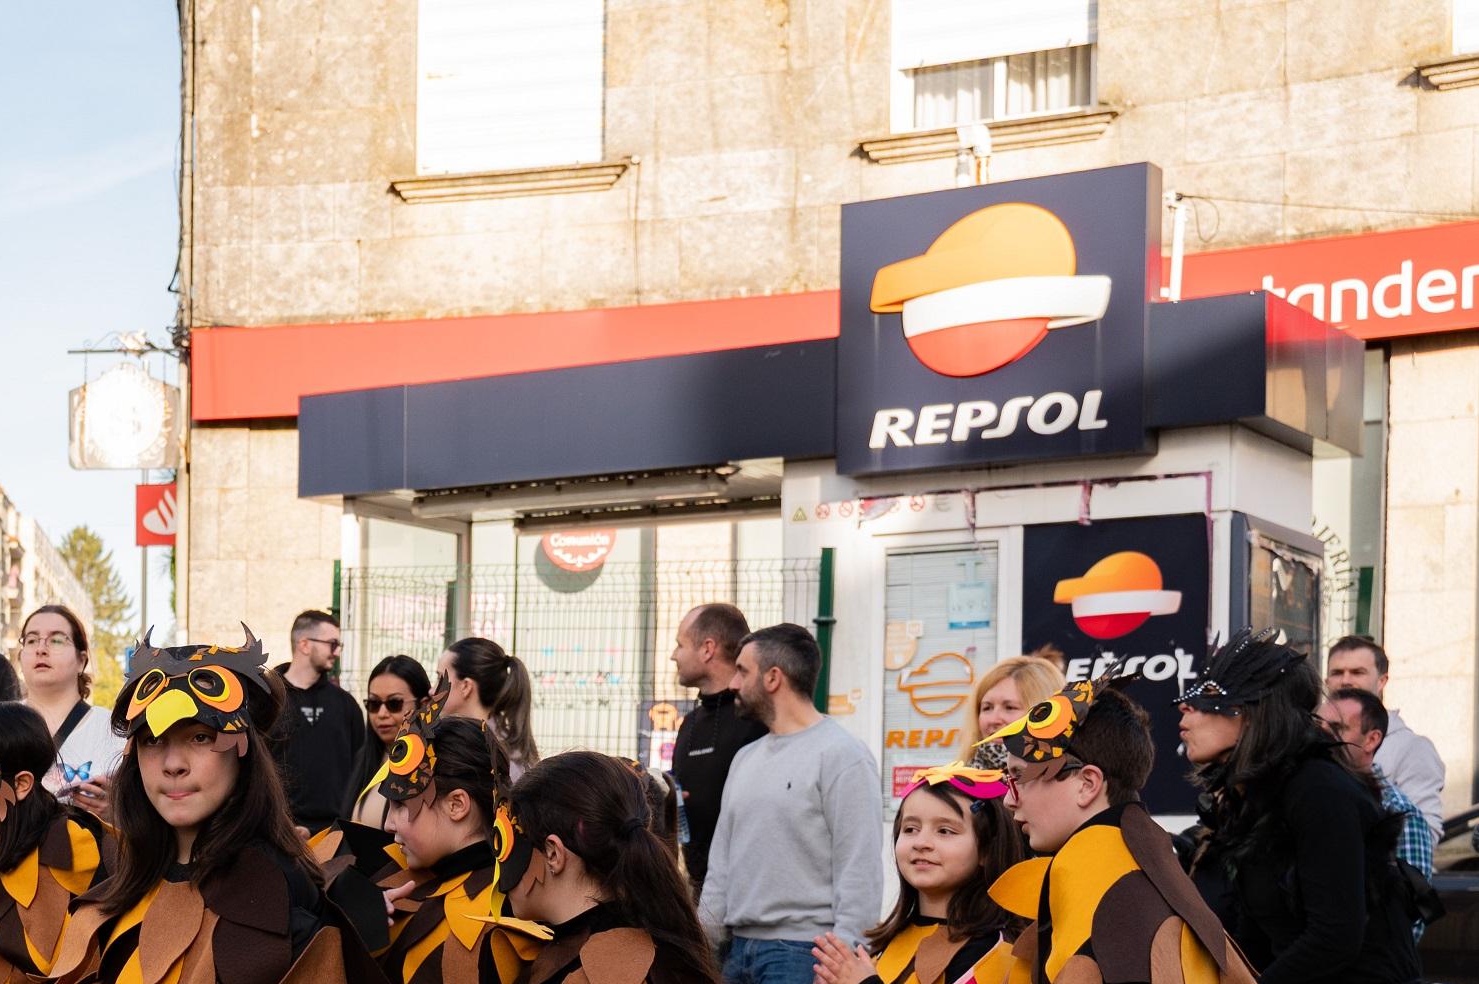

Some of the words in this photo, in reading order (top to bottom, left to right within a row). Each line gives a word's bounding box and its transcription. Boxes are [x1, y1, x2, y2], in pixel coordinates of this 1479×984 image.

[1262, 259, 1479, 324] tander
[868, 389, 1108, 449] REPSOL
[1065, 653, 1197, 682] EPSOL
[885, 727, 961, 749] REPS
